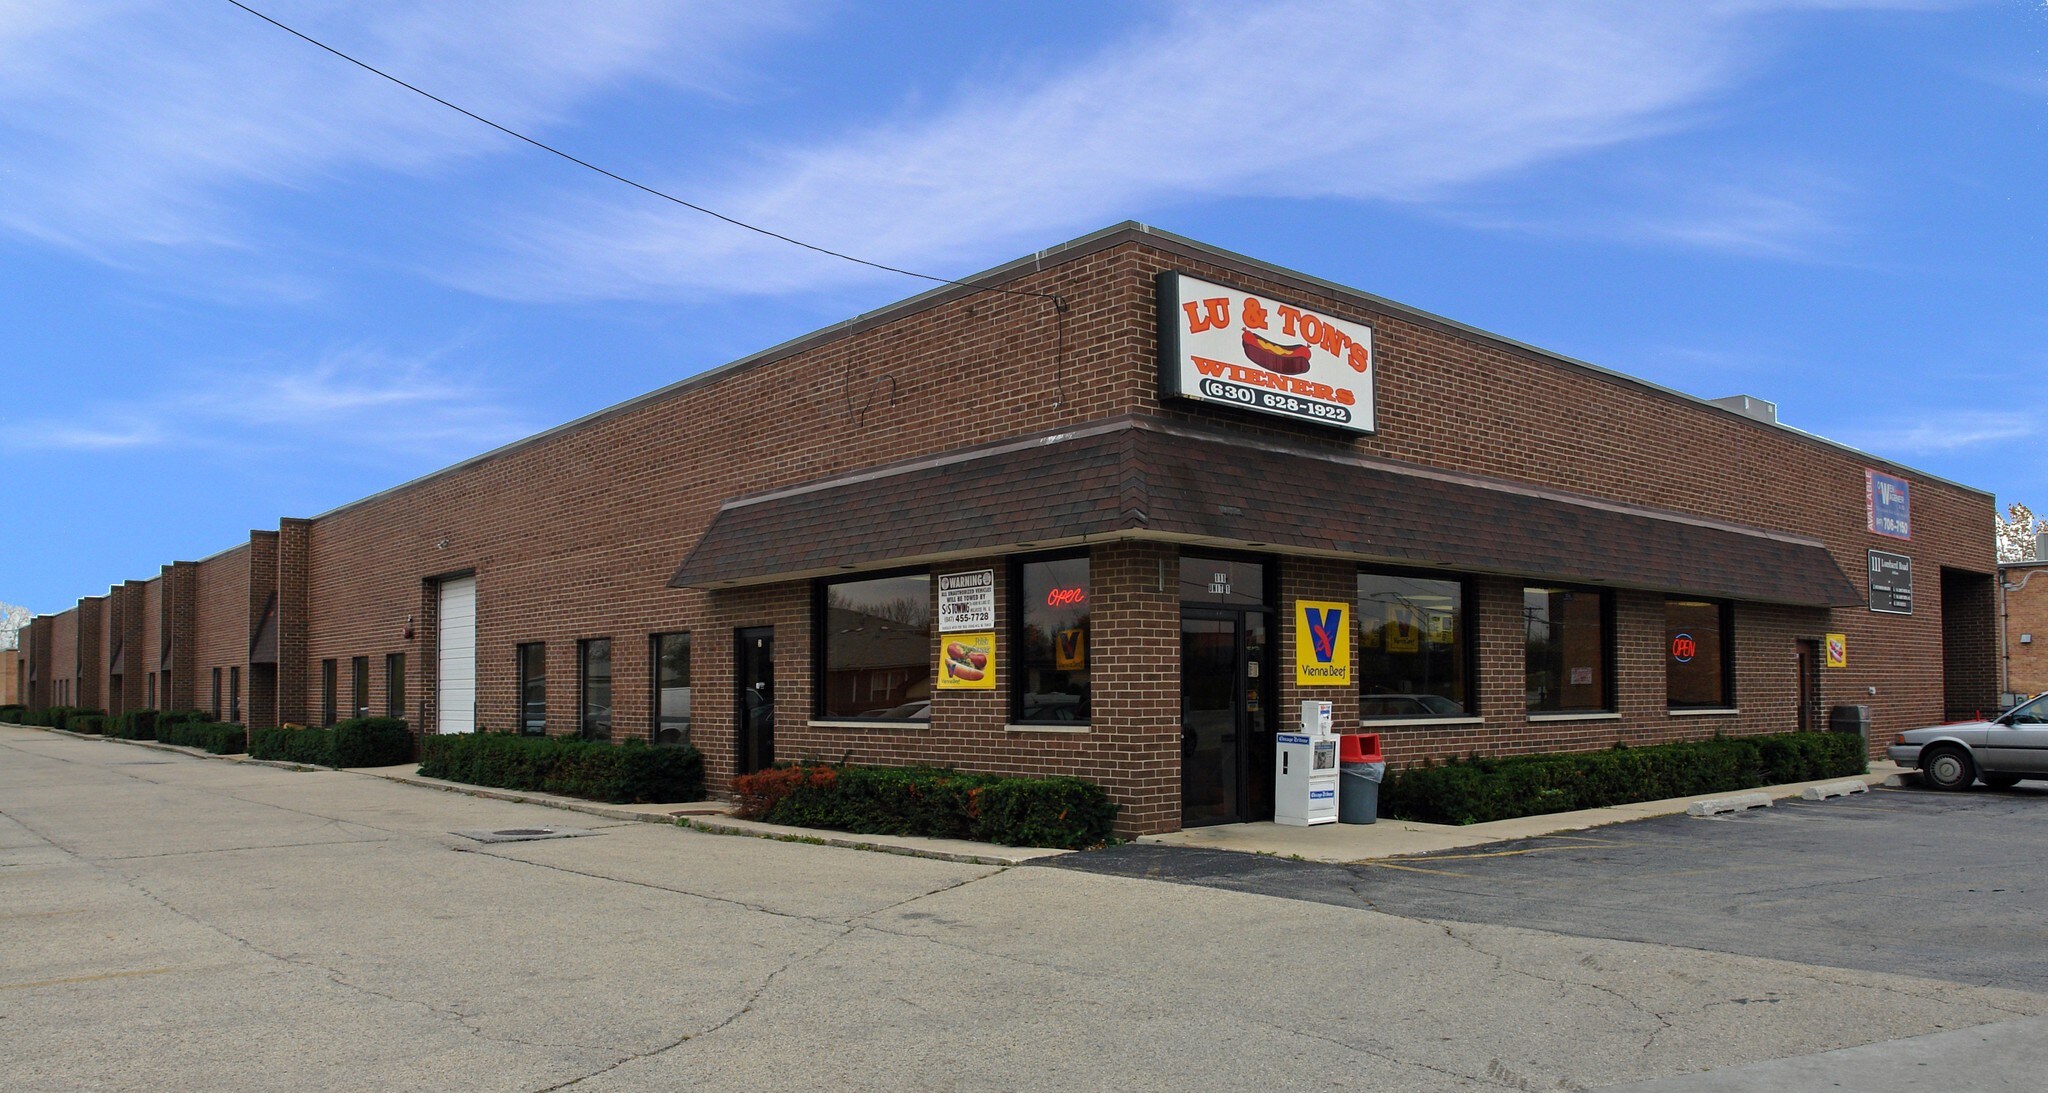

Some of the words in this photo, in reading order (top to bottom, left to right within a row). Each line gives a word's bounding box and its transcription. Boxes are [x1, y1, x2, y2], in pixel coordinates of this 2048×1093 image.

[1182, 297, 1231, 334] LU
[1241, 297, 1269, 330] &
[1277, 304, 1369, 374] TON'S
[1190, 355, 1356, 406] WIENERS
[1205, 379, 1255, 405] (630)
[1263, 394, 1347, 422] 628-1922
[1866, 470, 1874, 531] AVAILABLE
[1871, 556, 1881, 572] 111
[949, 574, 983, 588] WARNING
[955, 612, 989, 623] 455-7728
[1672, 639, 1695, 656] OPEN
